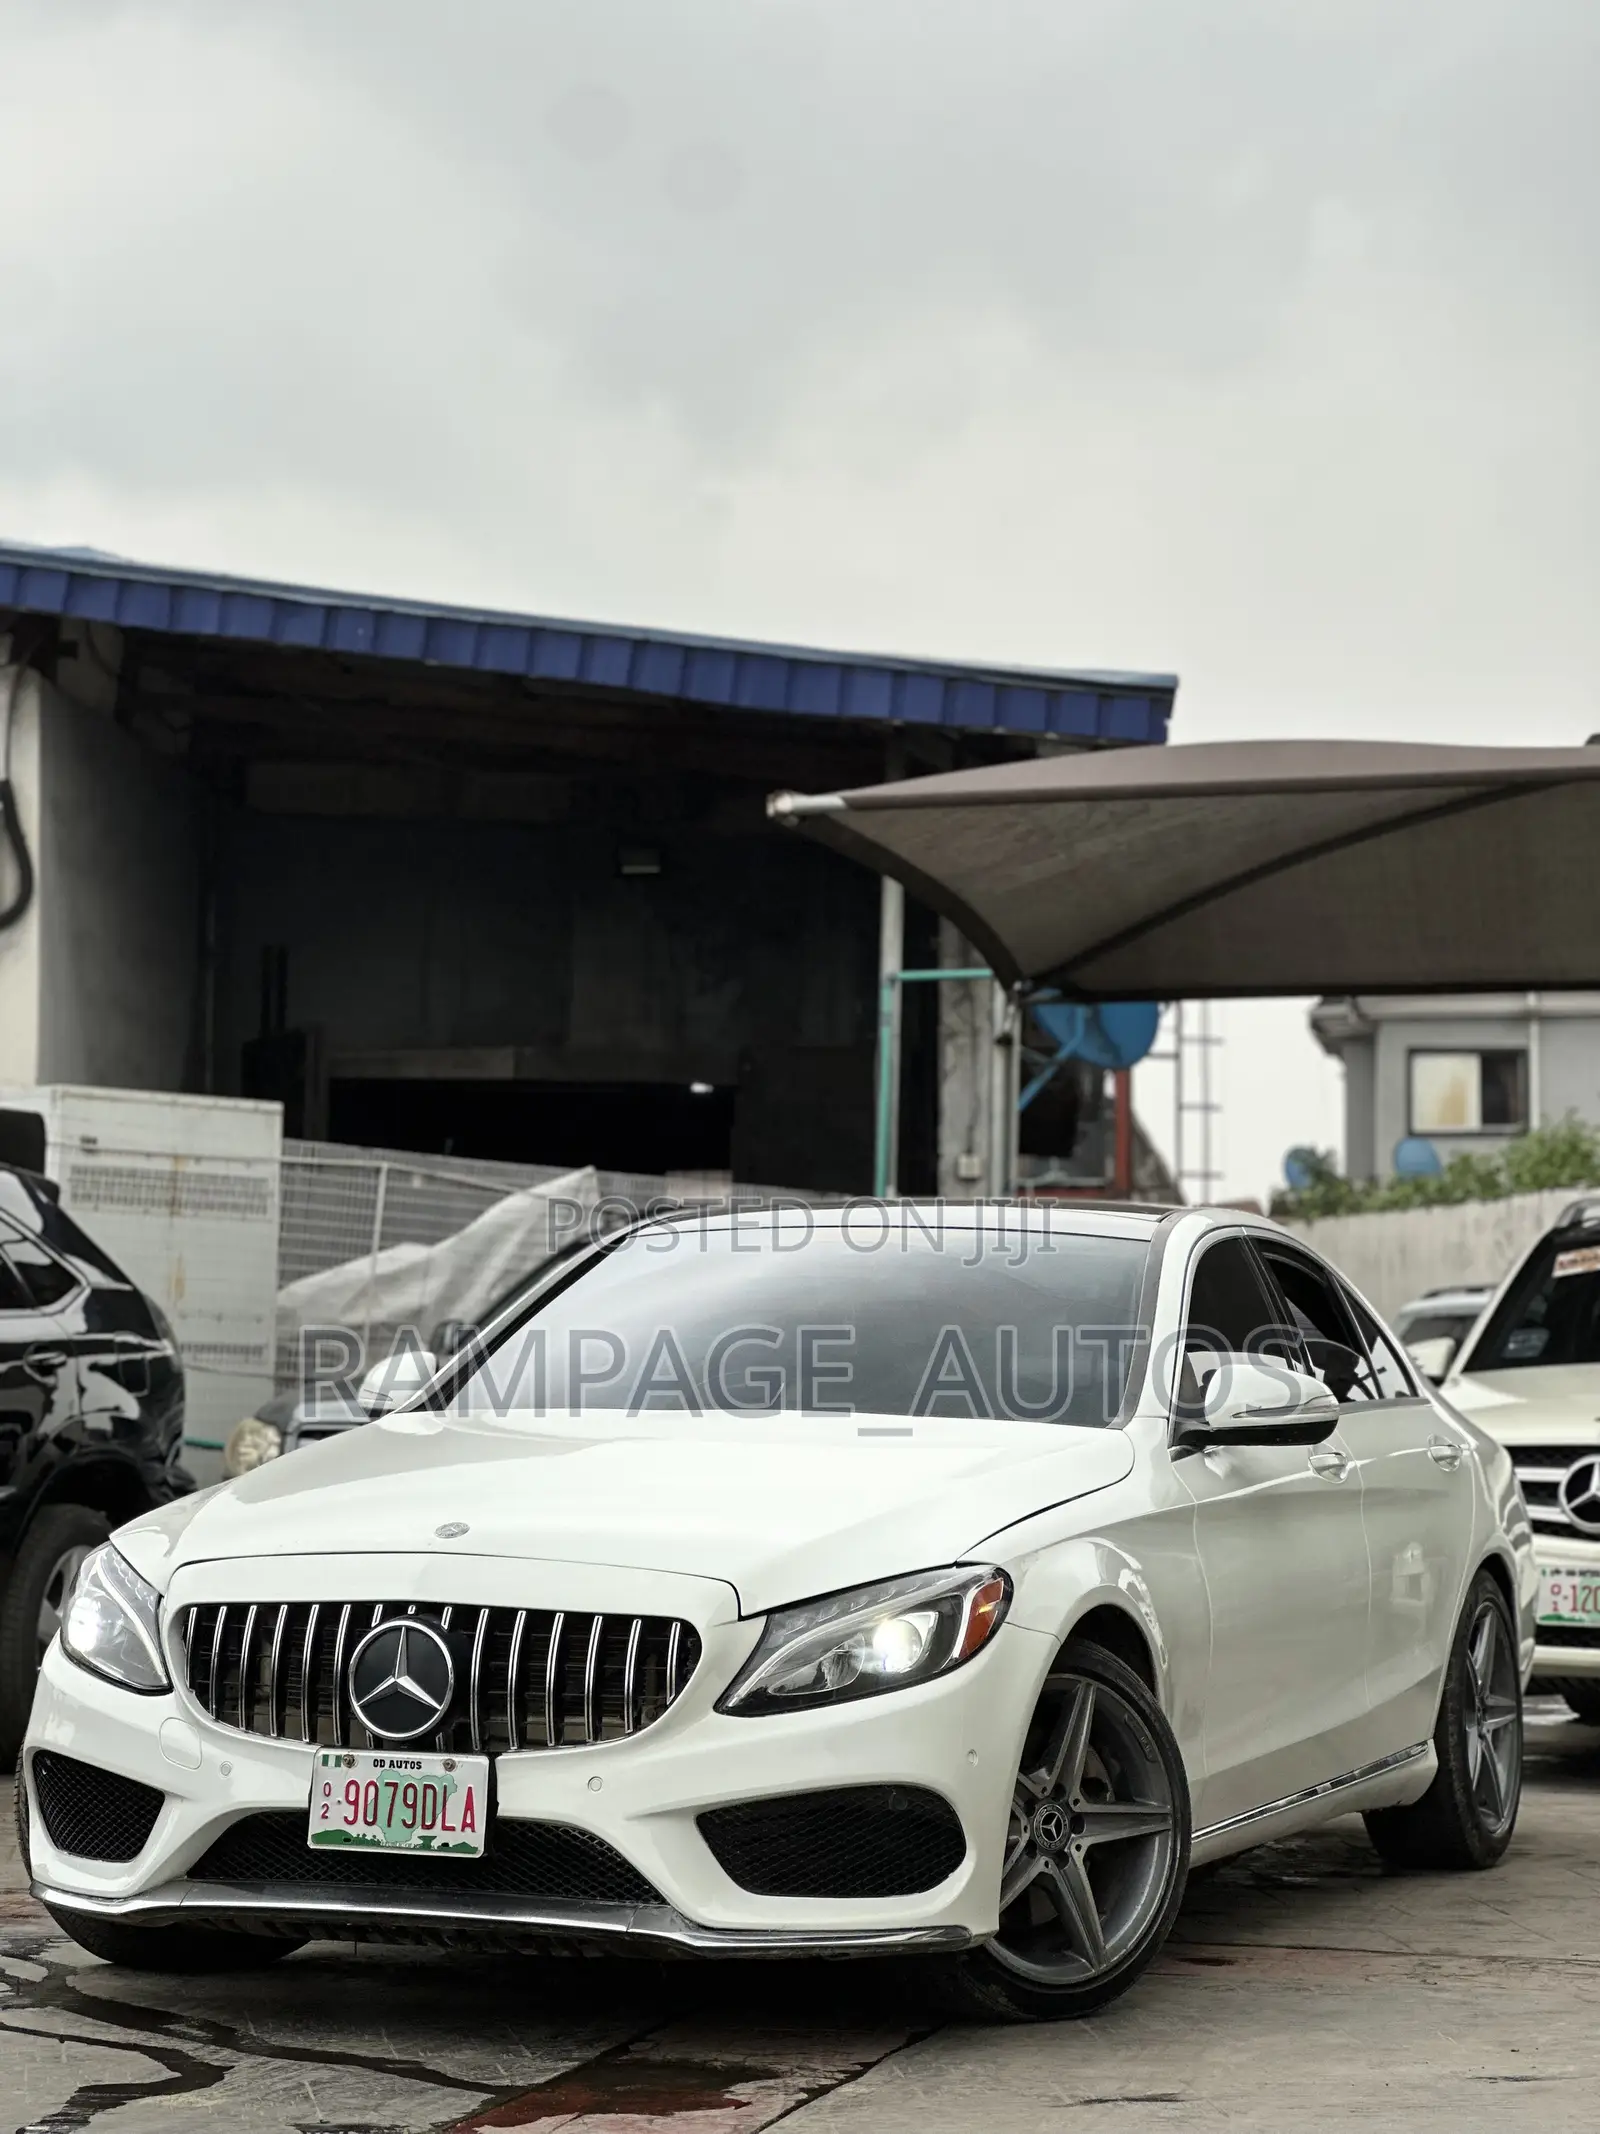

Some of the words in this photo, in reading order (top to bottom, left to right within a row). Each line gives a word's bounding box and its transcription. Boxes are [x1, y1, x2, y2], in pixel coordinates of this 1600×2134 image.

[373, 1758, 386, 1768] OD
[388, 1759, 422, 1770] AUTOS
[343, 1779, 476, 1833] 9079DLA
